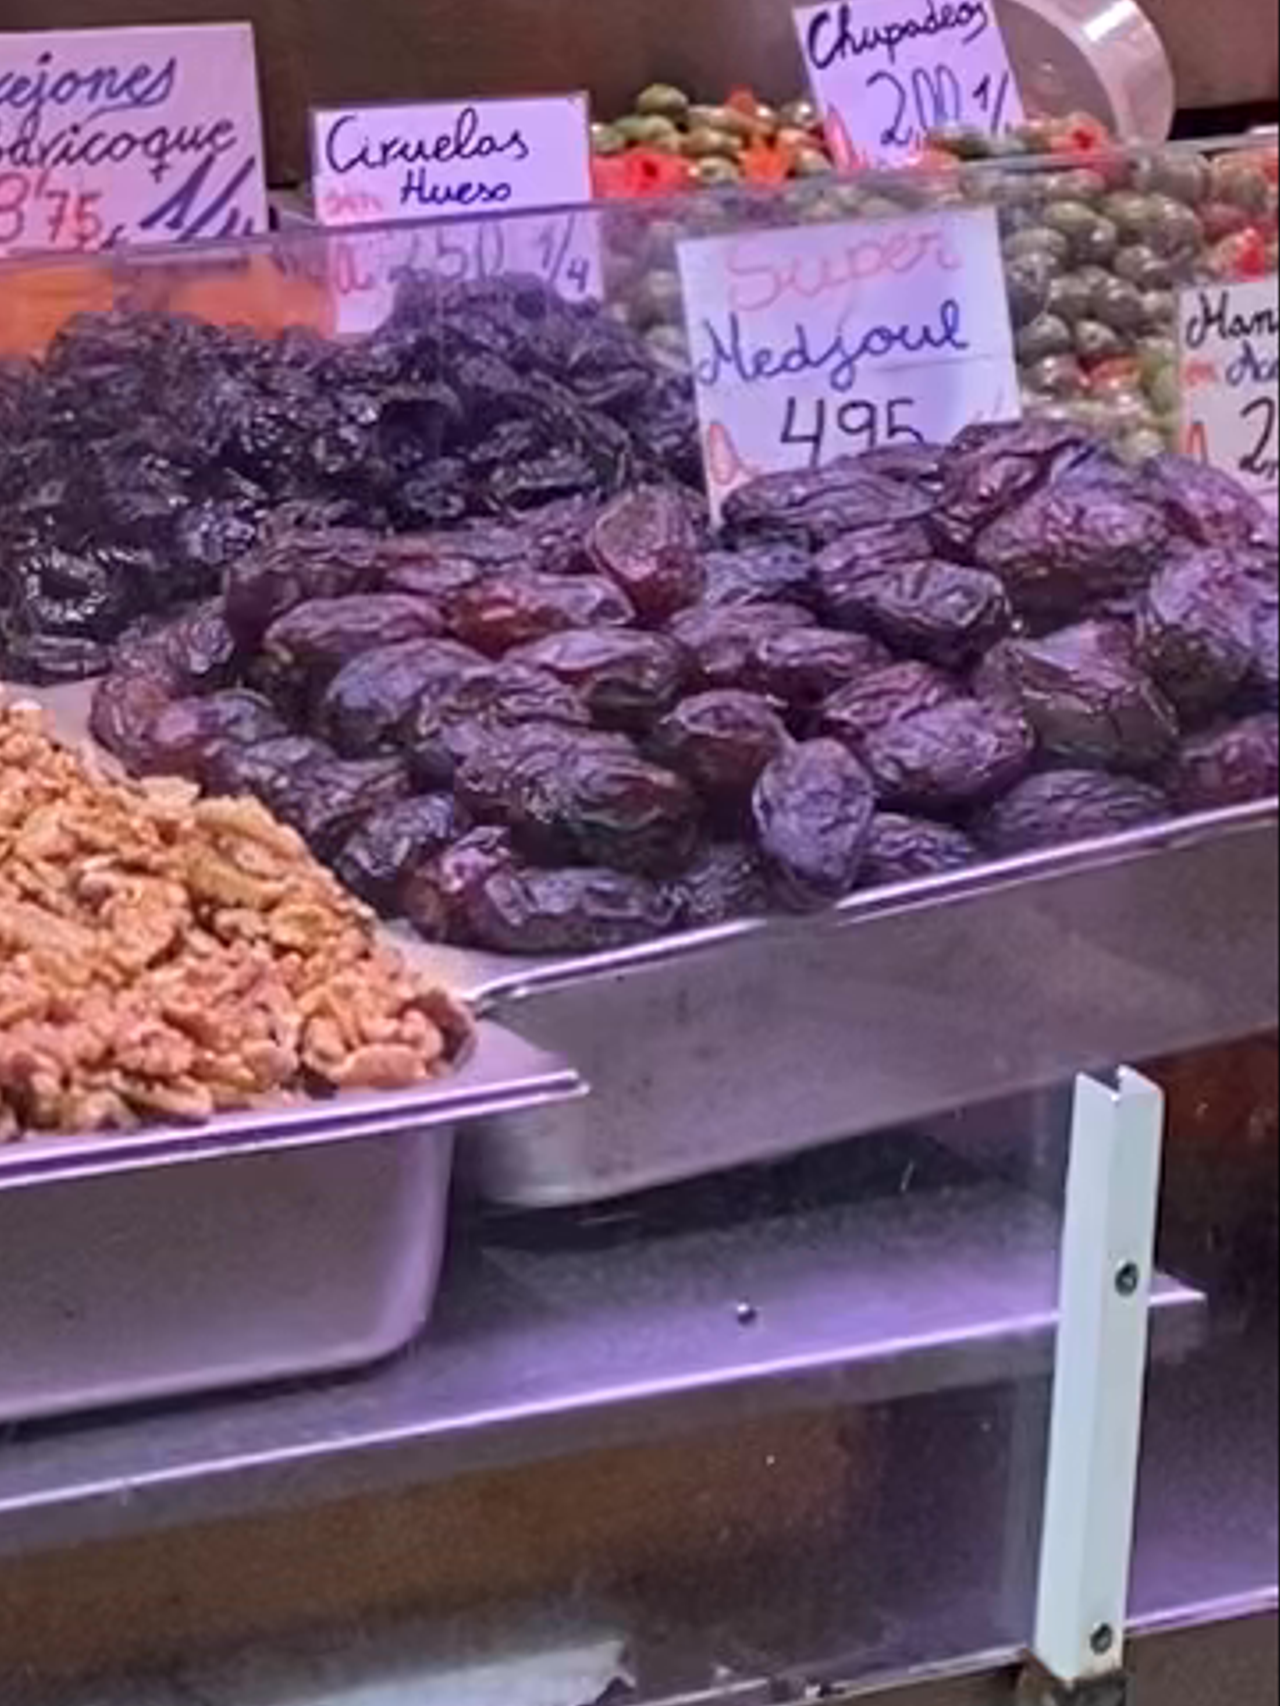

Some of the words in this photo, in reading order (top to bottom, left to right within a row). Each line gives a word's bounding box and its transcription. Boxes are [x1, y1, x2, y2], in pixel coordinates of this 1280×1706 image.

[325, 106, 531, 175] Ciruelas
[399, 167, 513, 205] Hueso
[726, 230, 963, 313] Super
